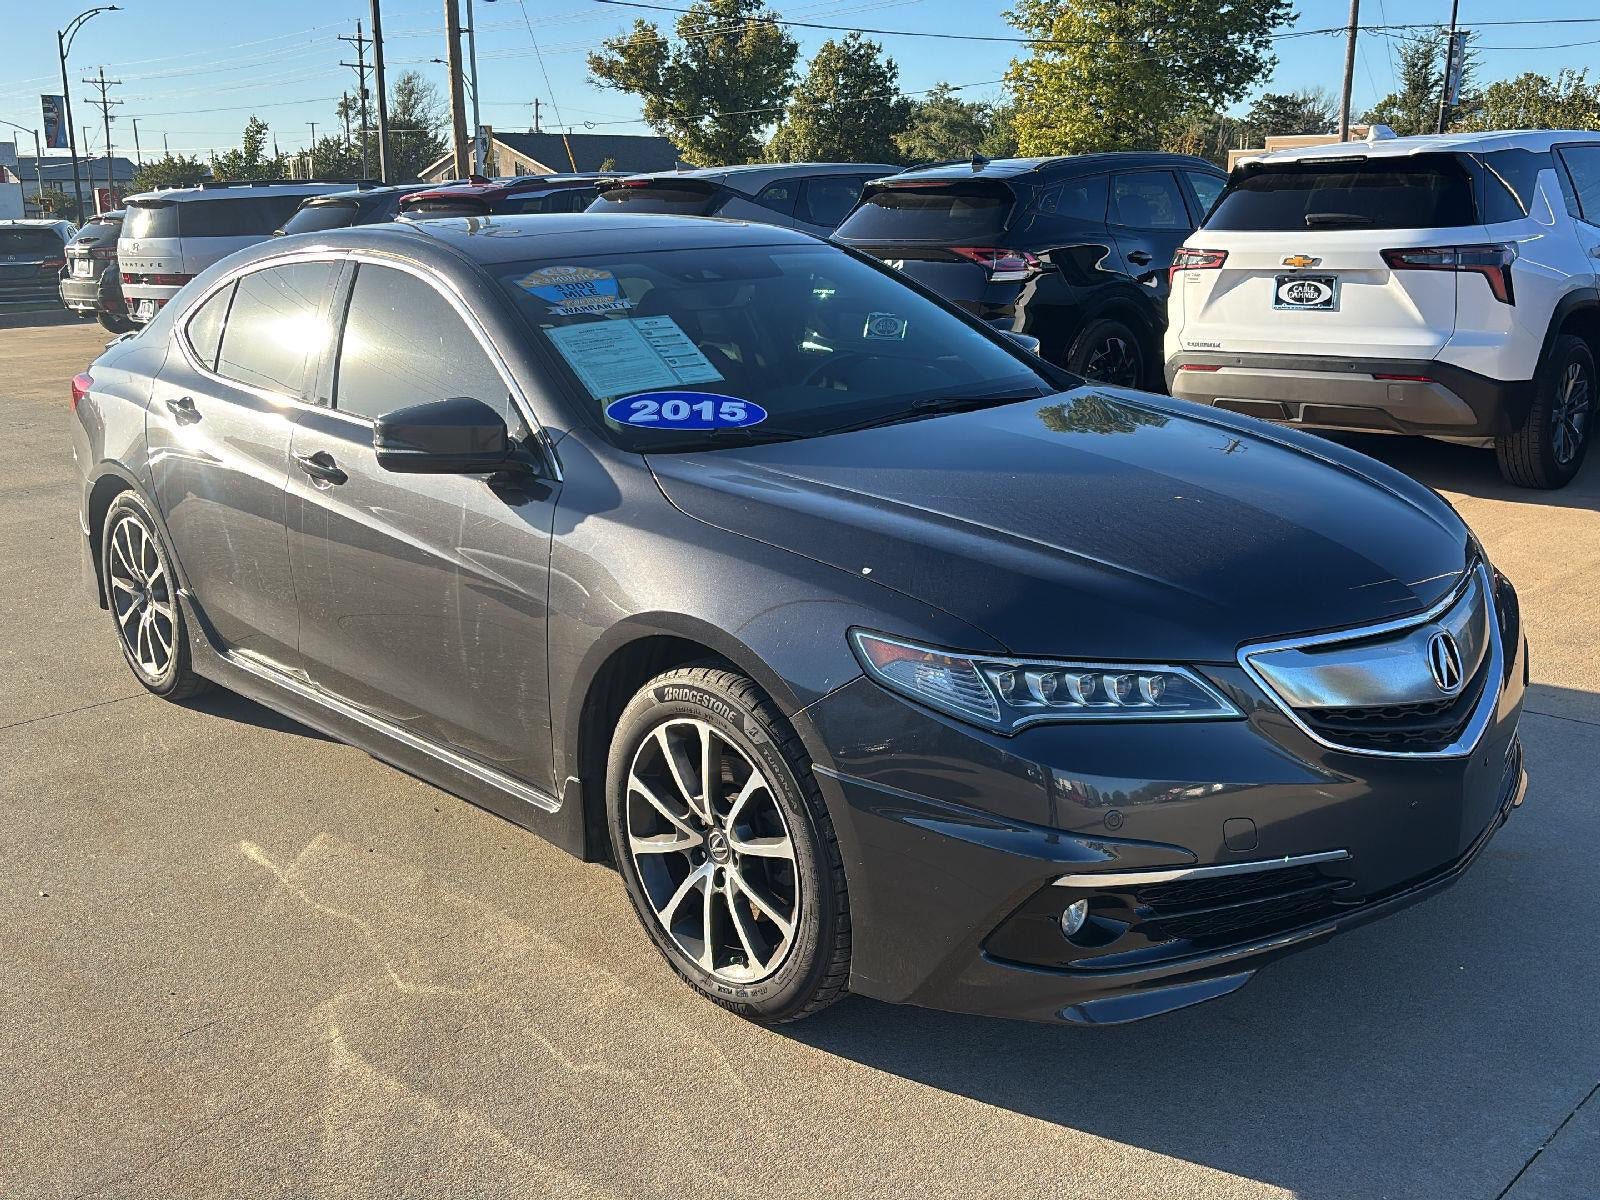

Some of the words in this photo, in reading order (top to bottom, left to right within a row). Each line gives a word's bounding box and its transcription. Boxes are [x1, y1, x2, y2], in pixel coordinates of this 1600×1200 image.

[562, 288, 601, 299] MILE
[1288, 291, 1319, 299] DAHMER
[560, 301, 626, 314] WARRANTY
[628, 400, 748, 422] 2015
[664, 687, 738, 723] BRIDGESTONE
[763, 749, 798, 811] TURANZA
